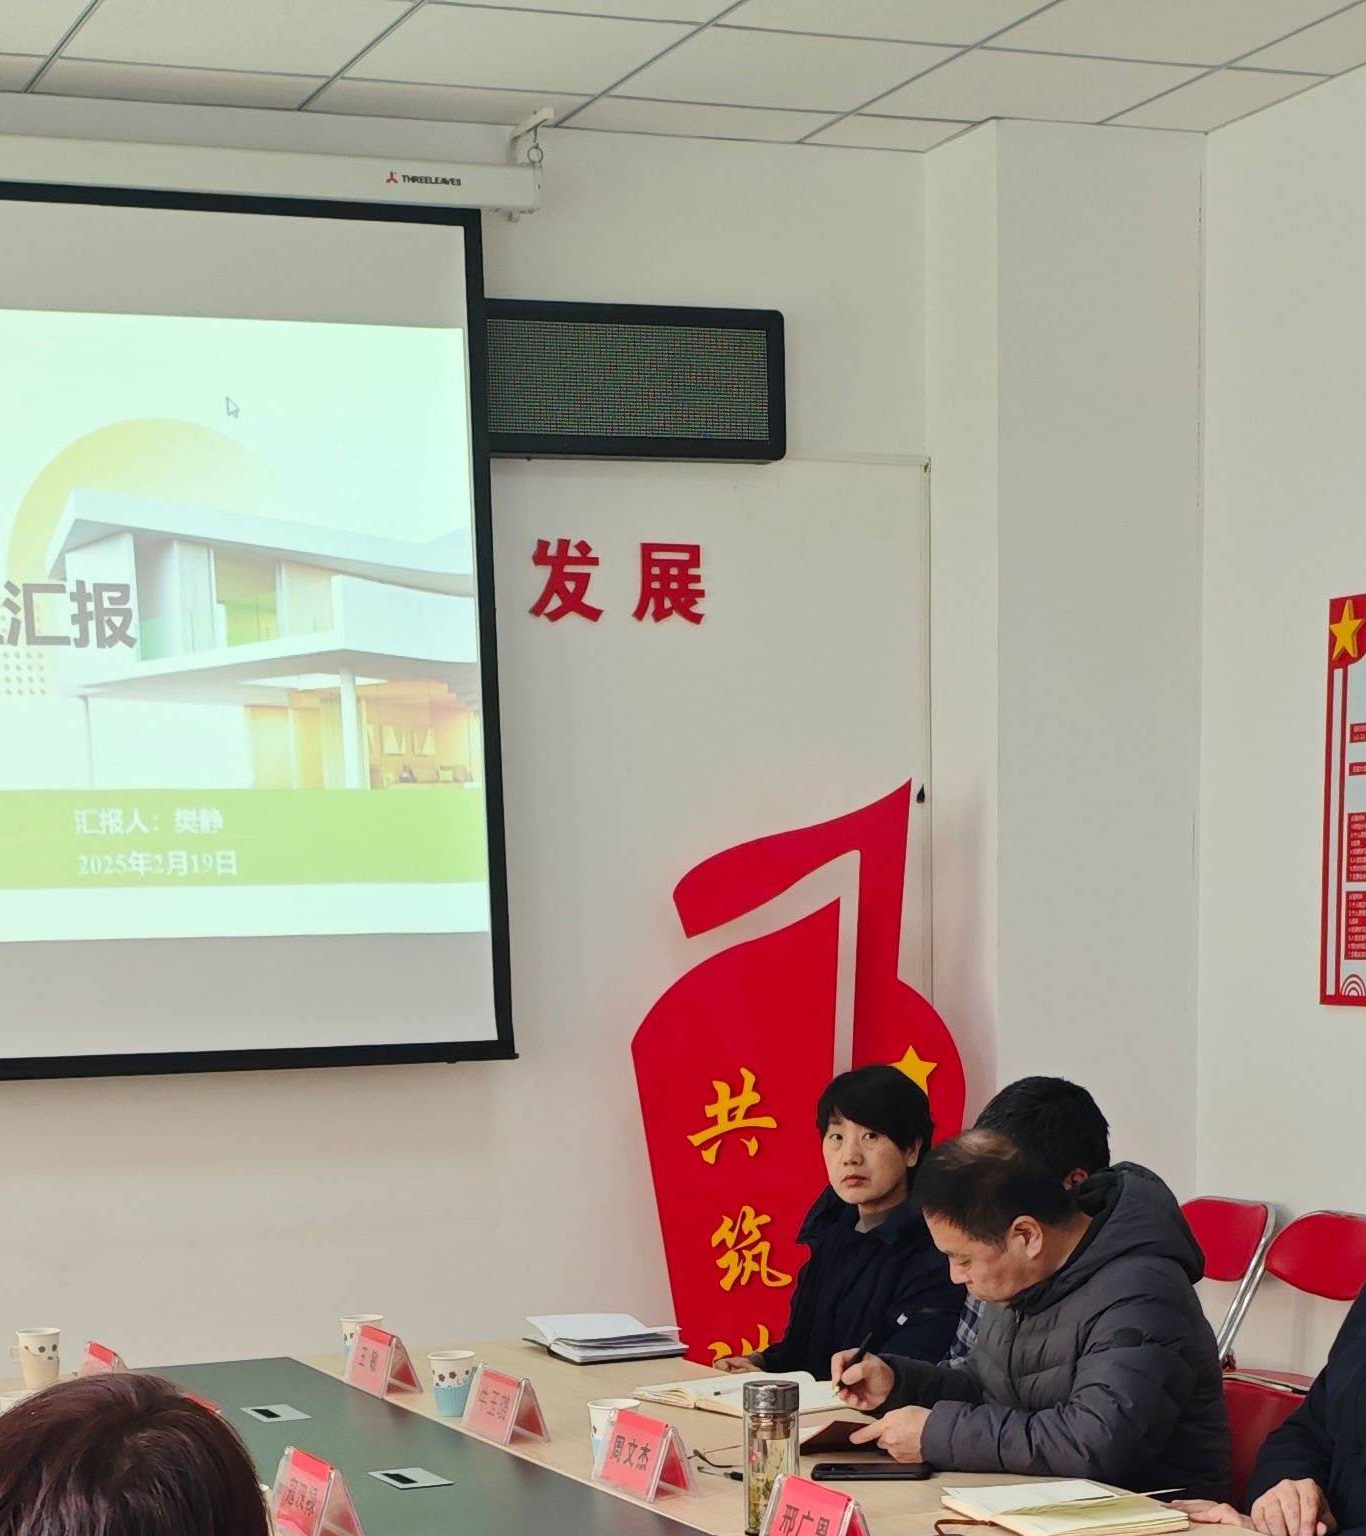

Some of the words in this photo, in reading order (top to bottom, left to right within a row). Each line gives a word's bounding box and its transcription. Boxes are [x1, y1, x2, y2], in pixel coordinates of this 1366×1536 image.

[529, 538, 706, 625] 发展
[77, 850, 238, 877] 2025年2月19日
